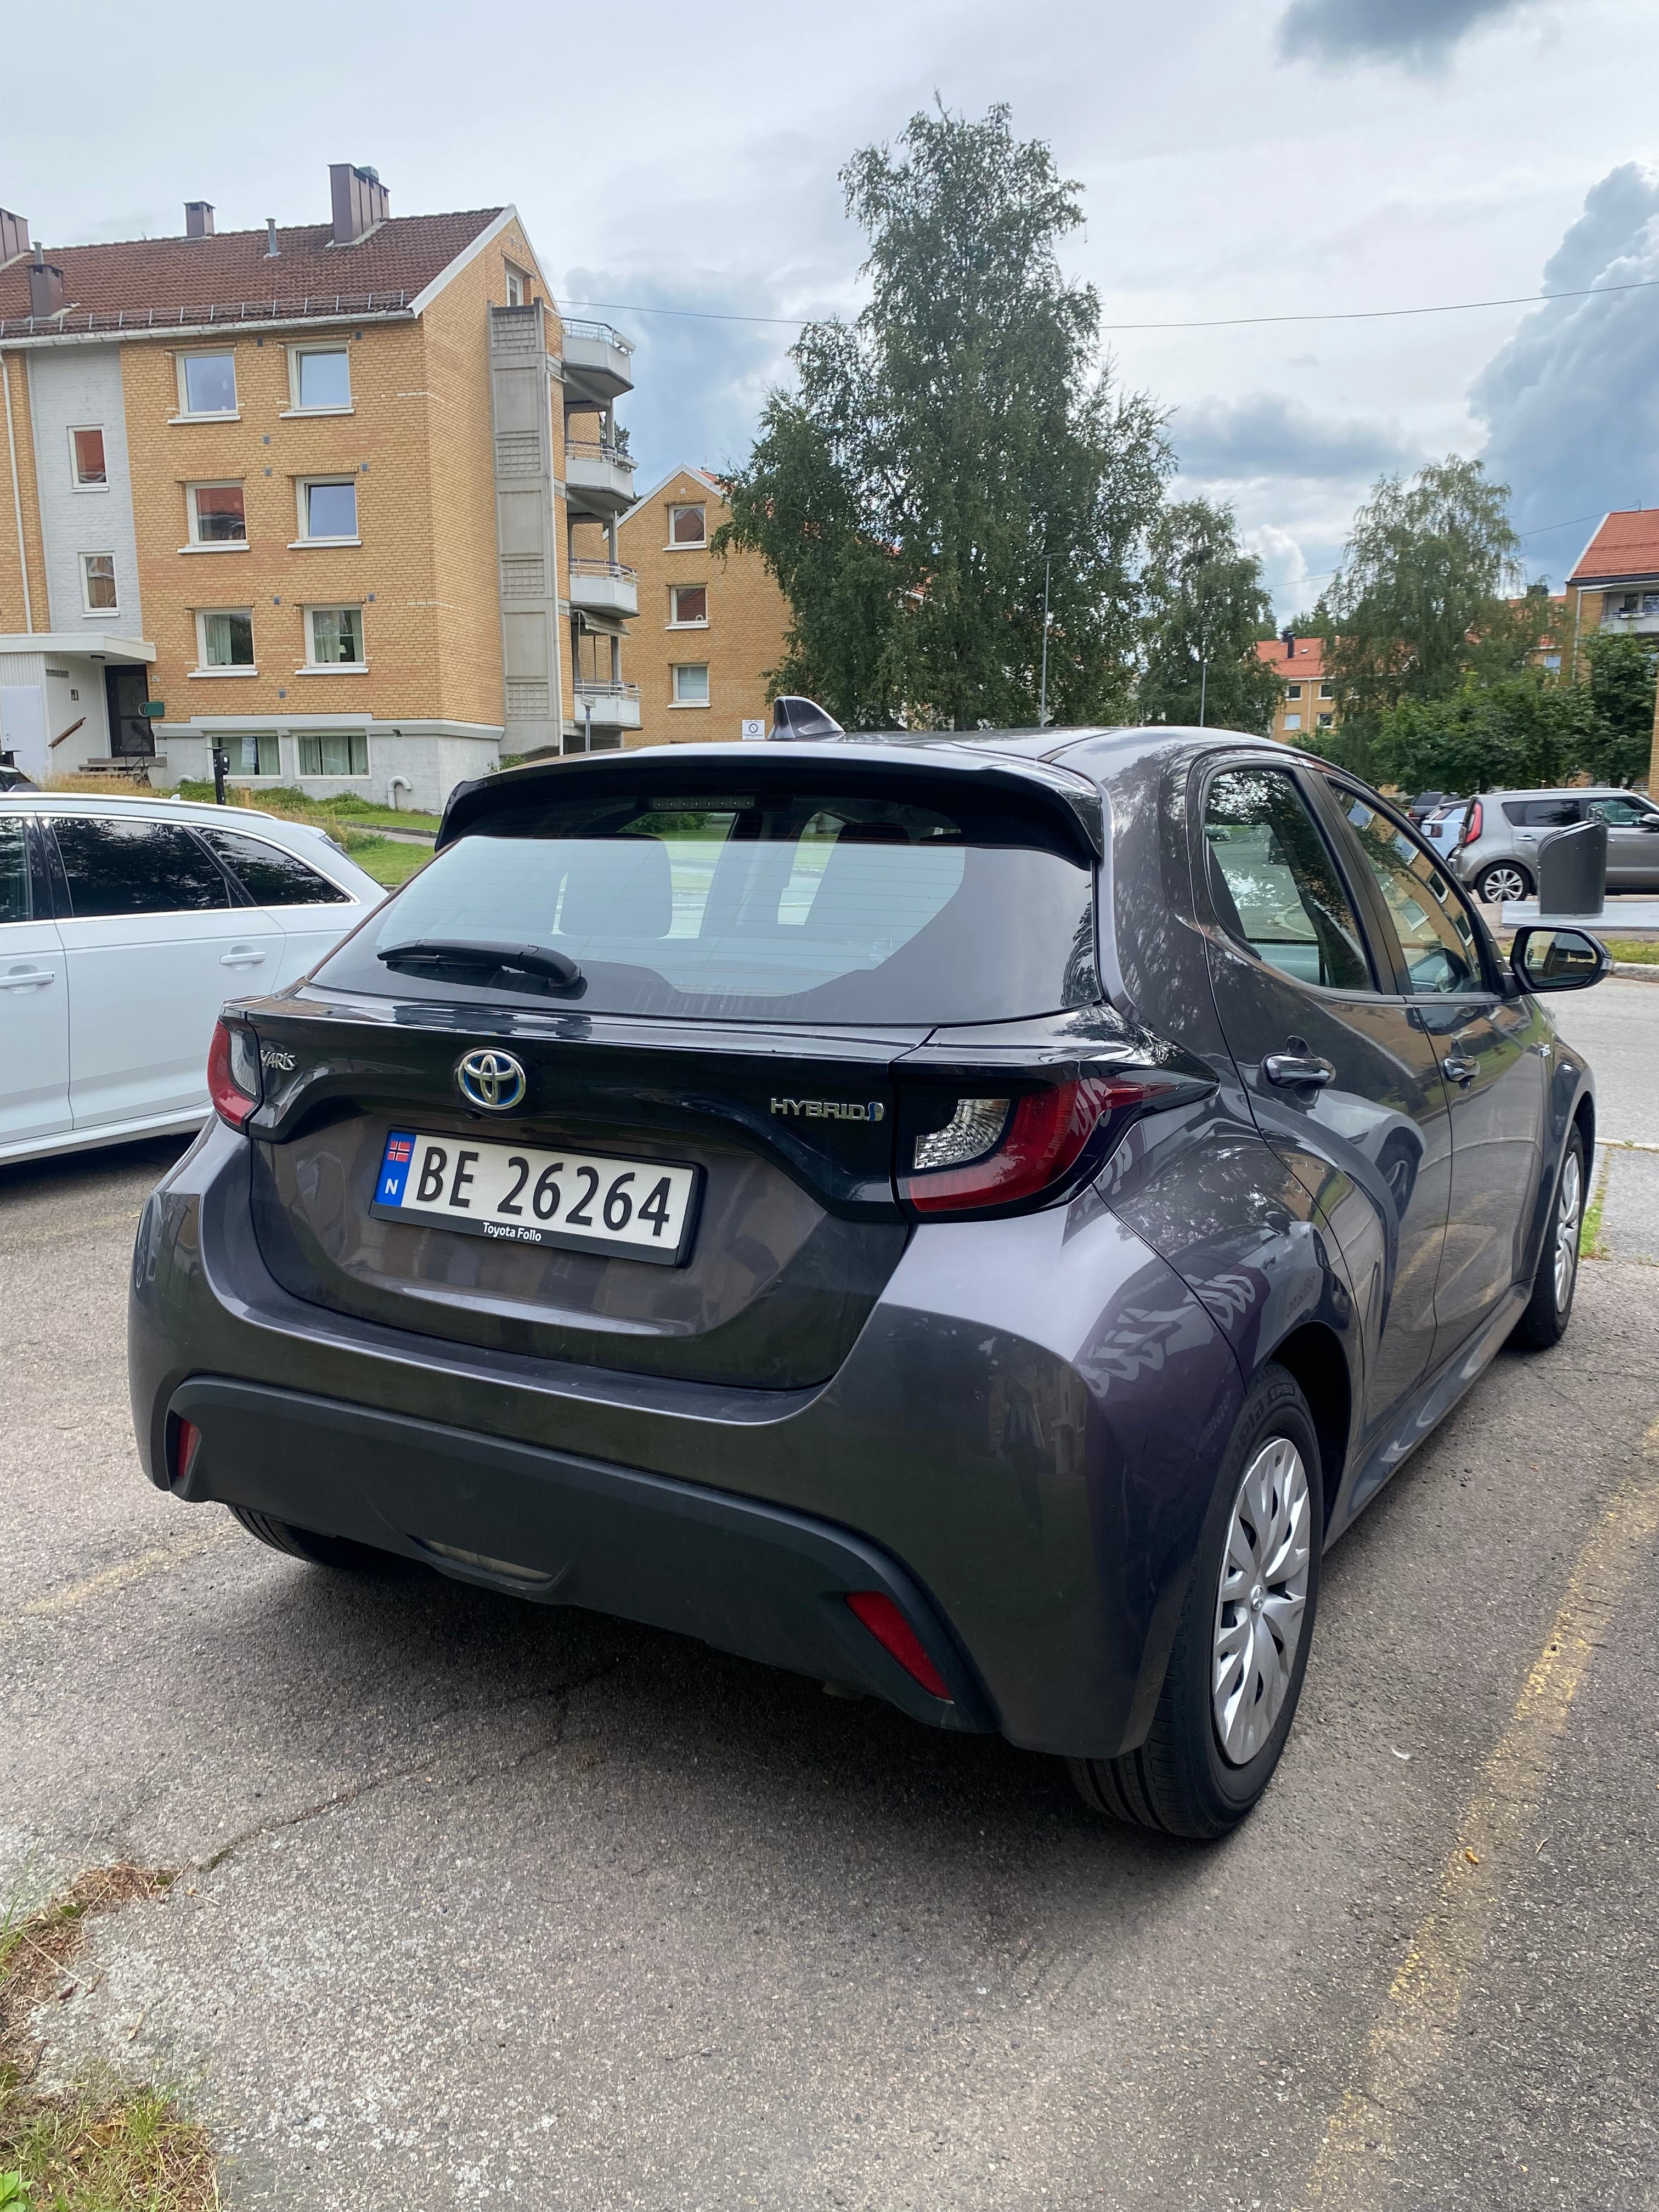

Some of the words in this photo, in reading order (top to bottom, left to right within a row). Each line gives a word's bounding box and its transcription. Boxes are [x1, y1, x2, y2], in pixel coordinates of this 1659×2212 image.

[771, 1098, 865, 1120] HYBRID
[385, 1178, 399, 1195] N
[416, 1147, 479, 1207] BE
[497, 1156, 672, 1237] 26264
[483, 1222, 516, 1238] Toyota
[517, 1227, 542, 1242] Follo
